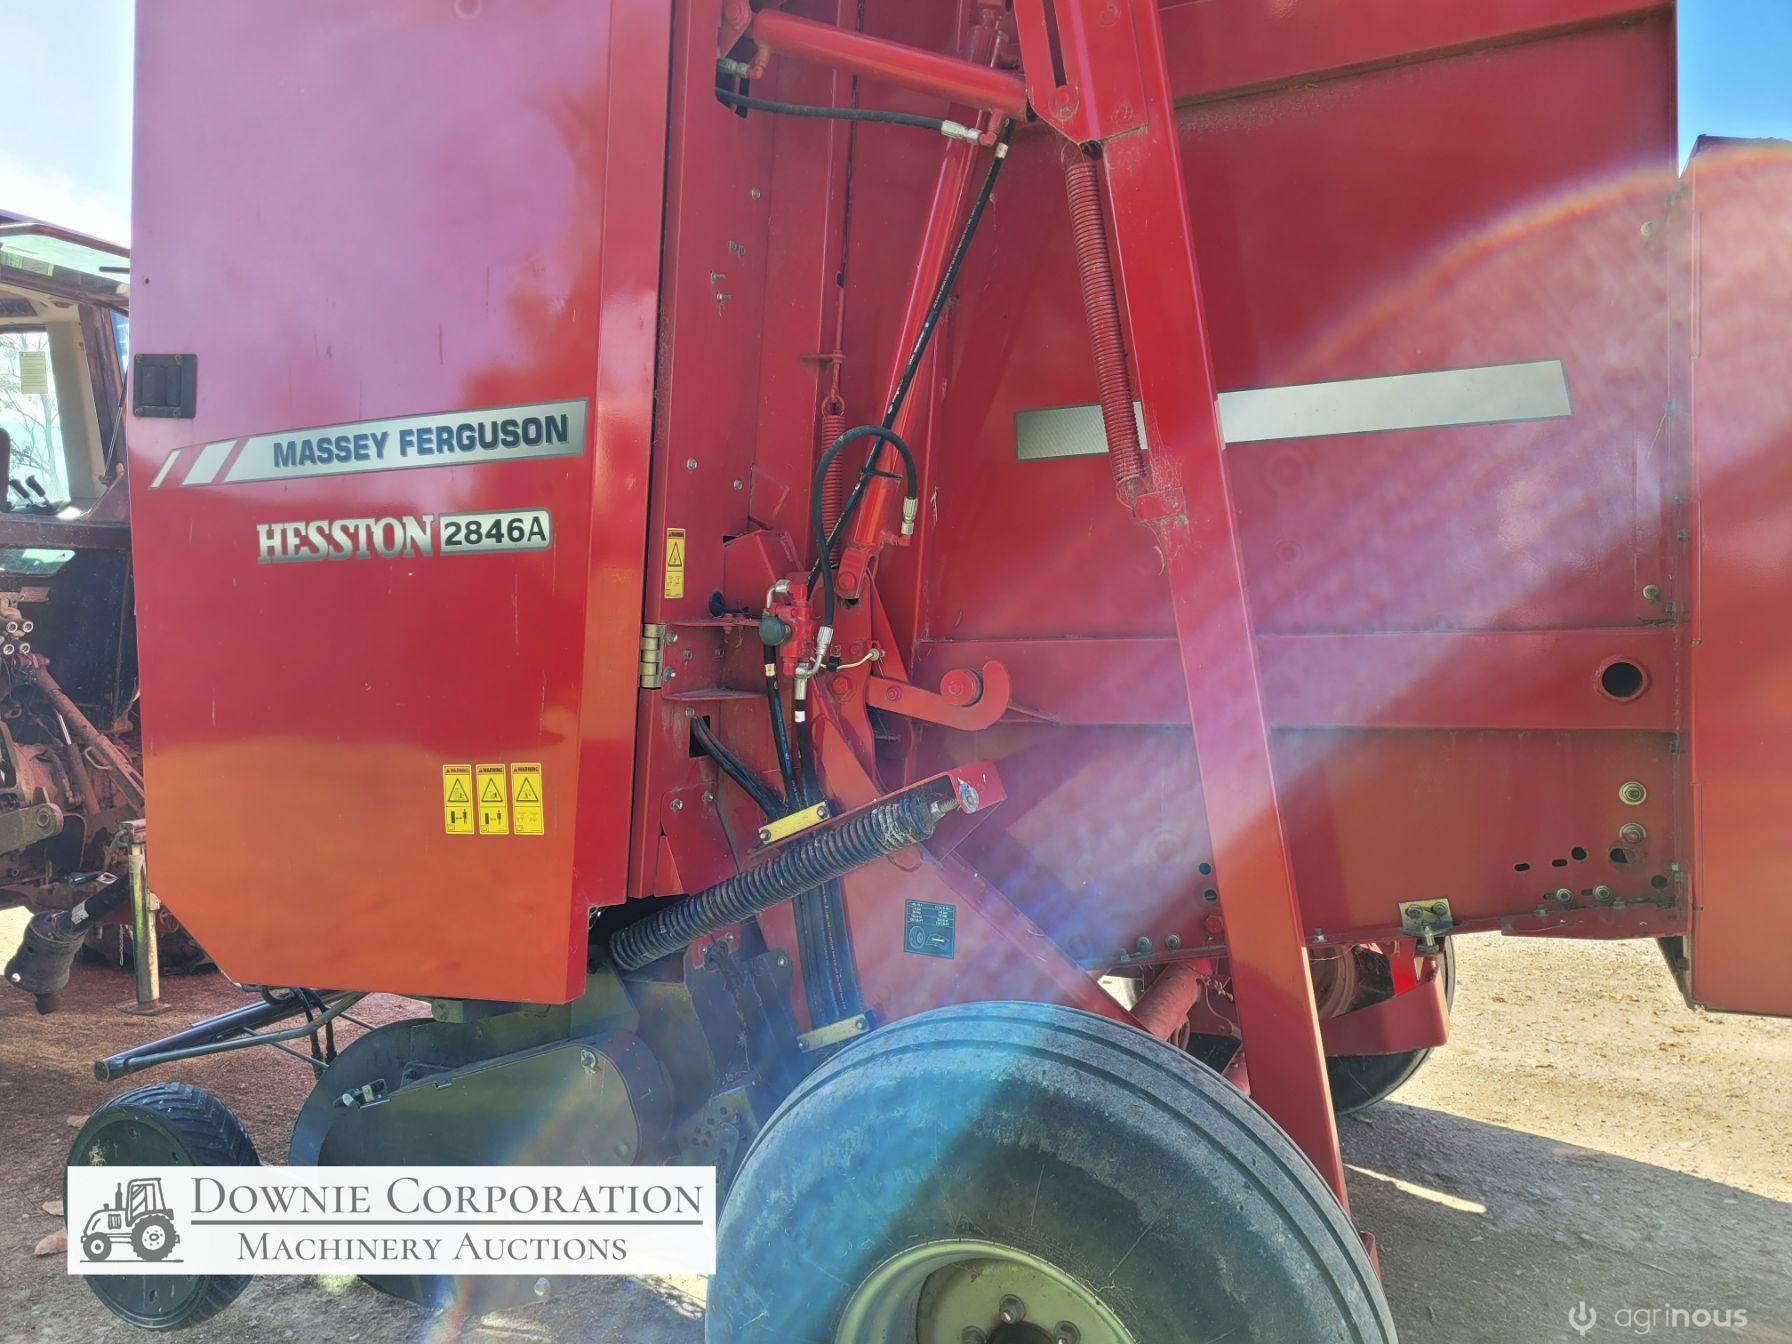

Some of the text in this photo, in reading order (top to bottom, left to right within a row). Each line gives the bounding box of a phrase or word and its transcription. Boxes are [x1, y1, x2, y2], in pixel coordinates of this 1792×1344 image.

[273, 414, 567, 468] MASSEY FERGUSON
[256, 515, 548, 562] HESSTON 2846A
